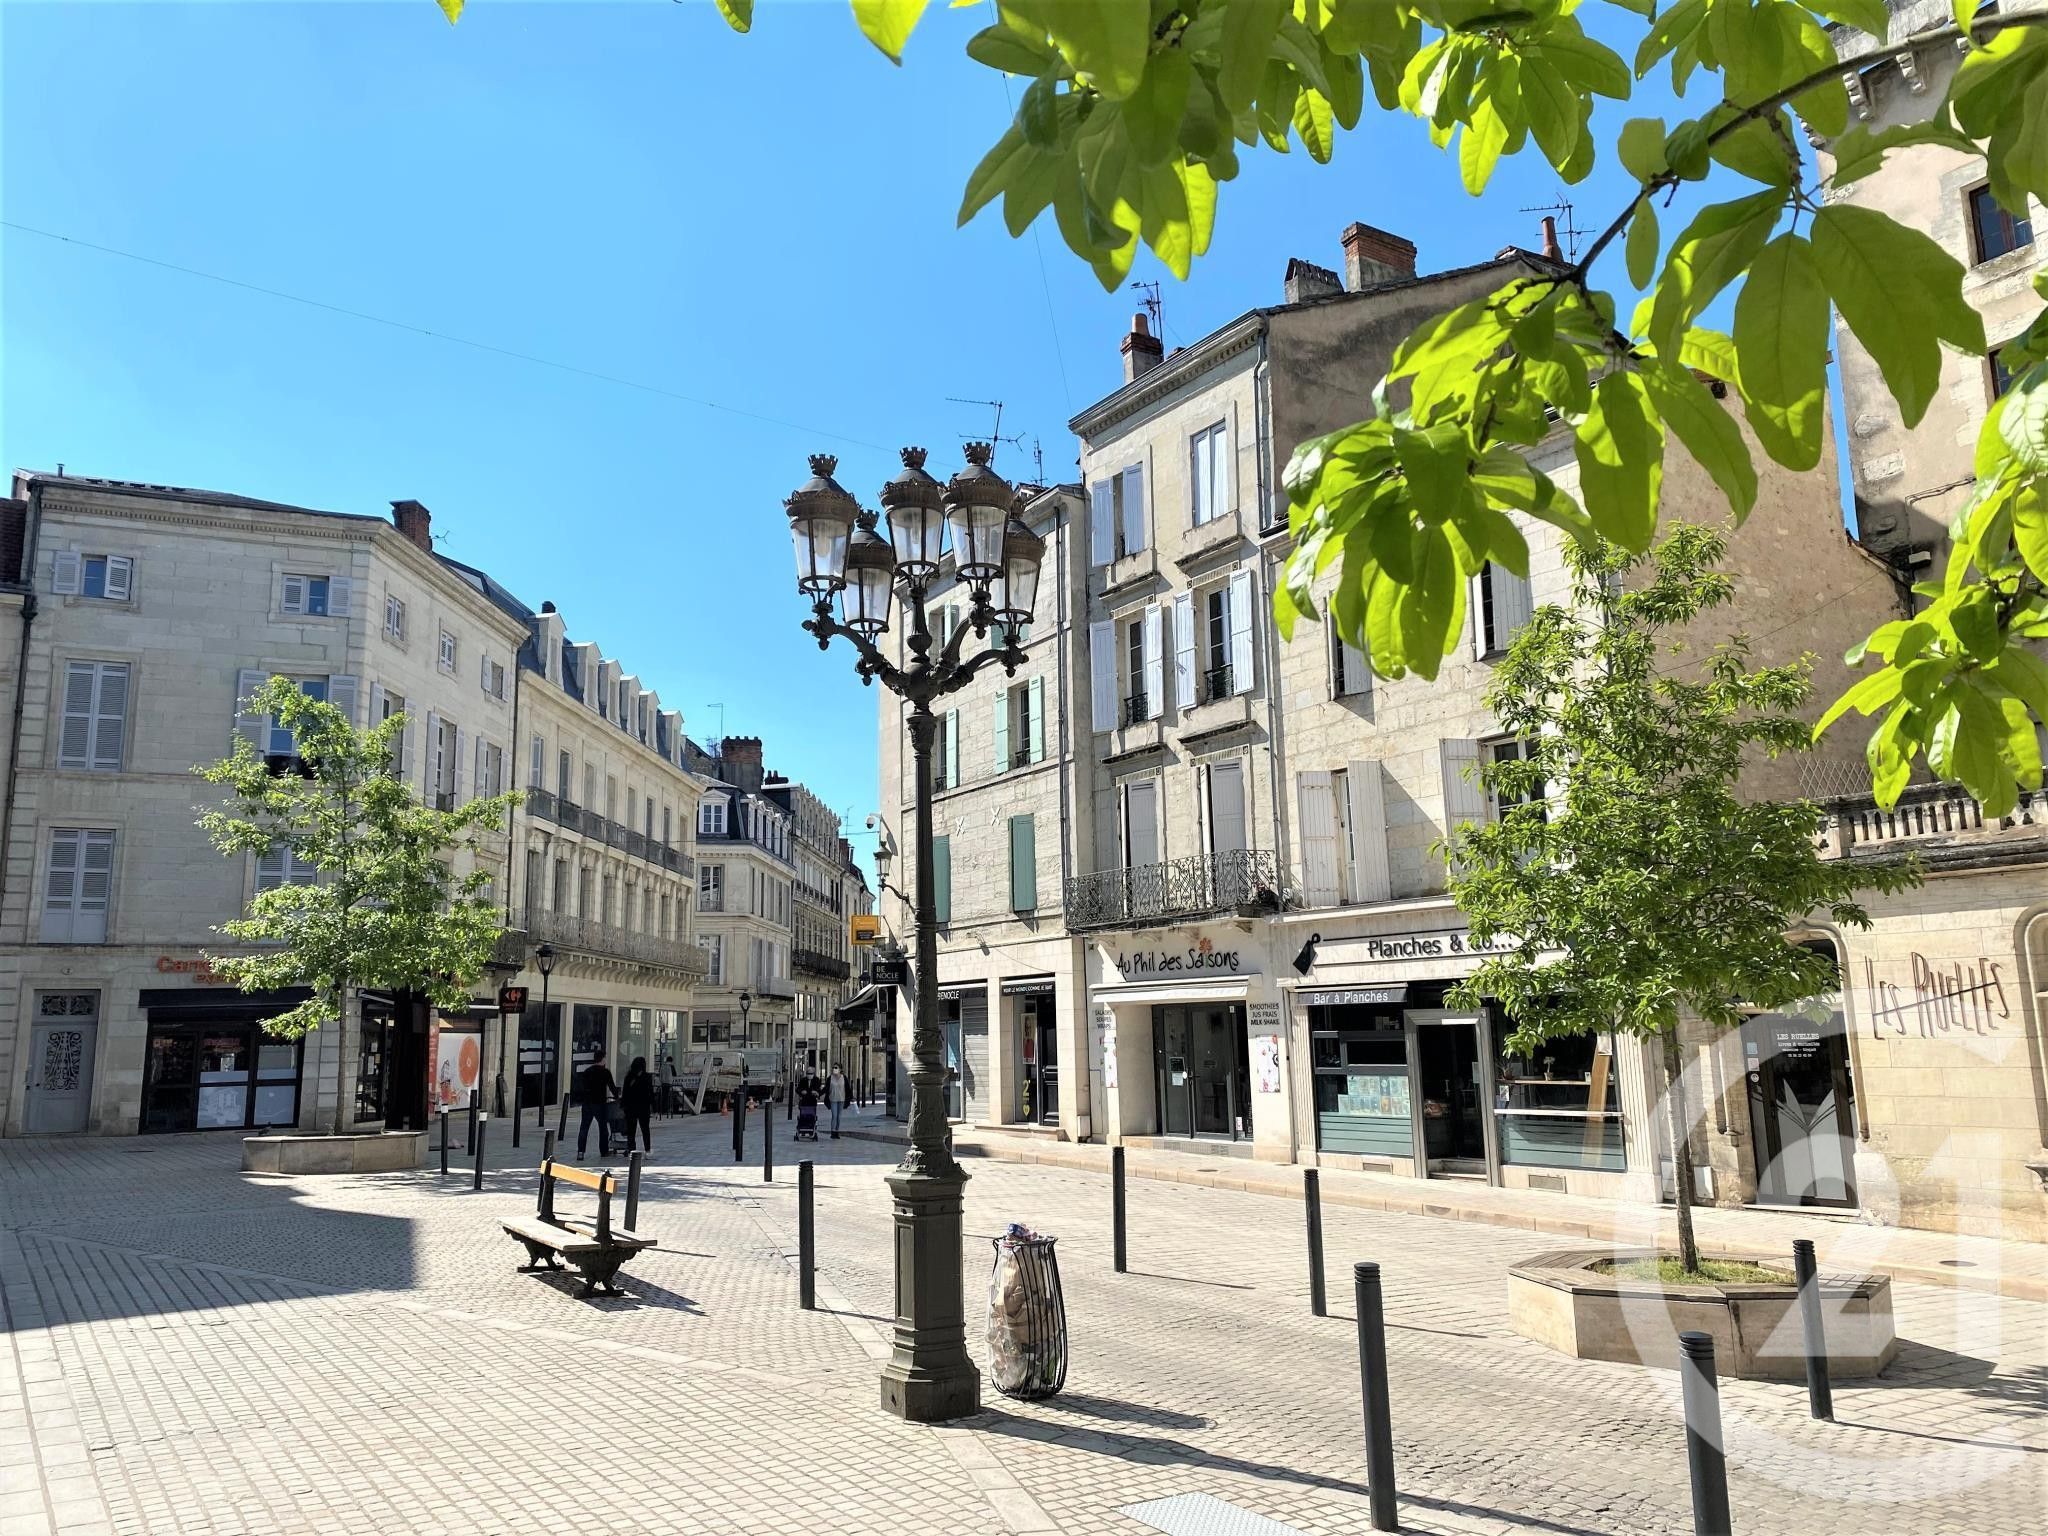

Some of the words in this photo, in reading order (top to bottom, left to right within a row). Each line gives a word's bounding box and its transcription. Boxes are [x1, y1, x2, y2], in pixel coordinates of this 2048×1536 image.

[1368, 937, 1441, 958] Planches
[1450, 934, 1464, 952] &
[1115, 952, 1131, 980] Au
[1133, 951, 1155, 974] Phil
[1159, 952, 1182, 971] des
[1186, 947, 1239, 971] Saisons
[1313, 993, 1330, 1004] Bar
[1334, 993, 1340, 1003] à
[1344, 990, 1389, 1004] Planches
